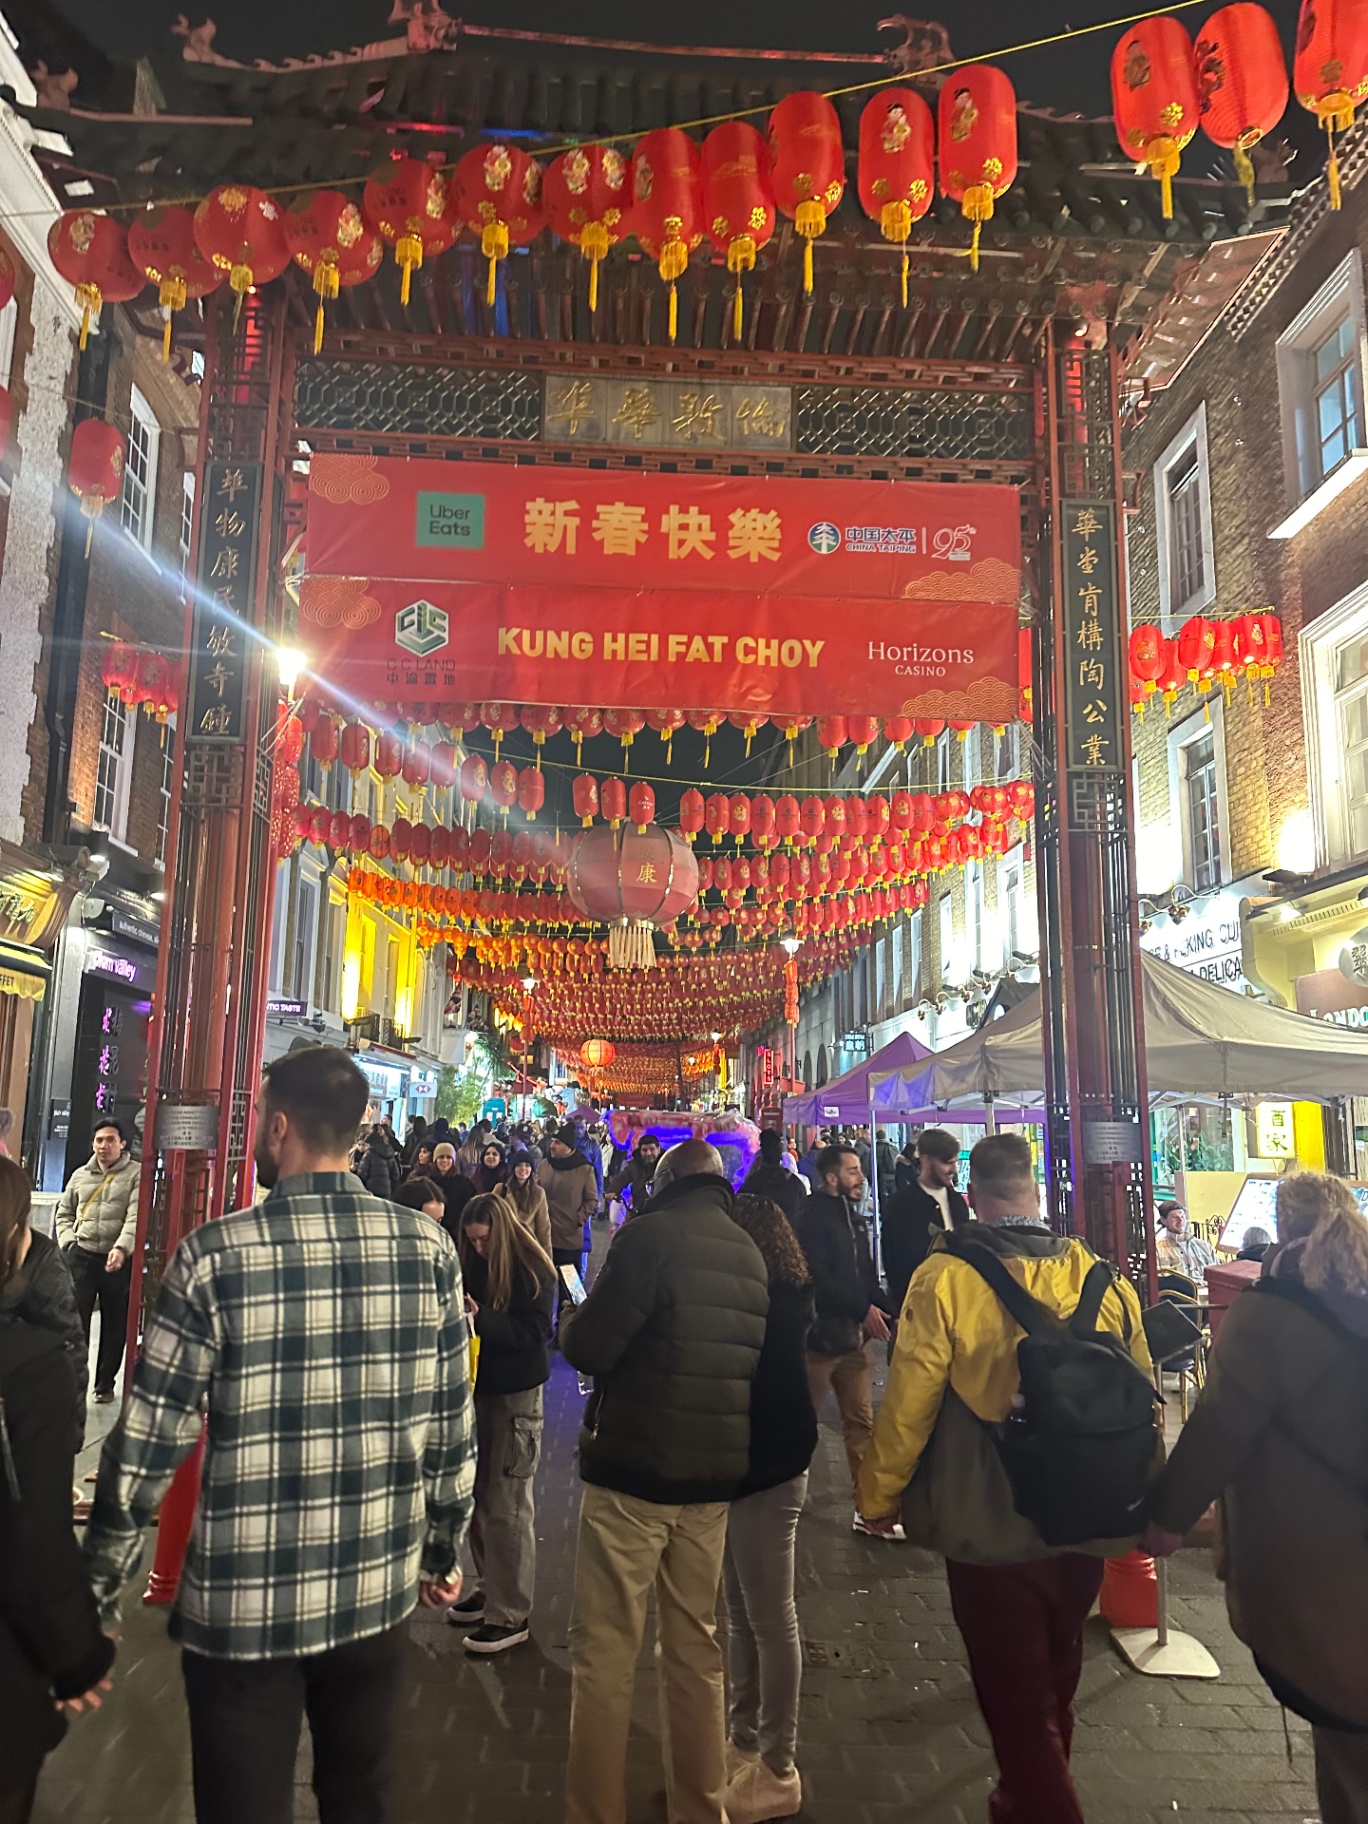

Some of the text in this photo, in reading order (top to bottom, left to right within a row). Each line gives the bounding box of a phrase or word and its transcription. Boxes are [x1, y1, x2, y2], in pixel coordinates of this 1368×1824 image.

[429, 504, 470, 521] Uber
[429, 521, 470, 537] Eats
[523, 496, 783, 563] 新春快樂
[845, 526, 917, 544] 中国太平
[846, 543, 917, 554] CHINA TAIPING
[1071, 507, 1110, 766] 華堂肯構陶公業
[498, 627, 826, 668] KUNG HEI FAT CHOY
[868, 641, 974, 664] Horizons
[895, 664, 946, 677] CASINO
